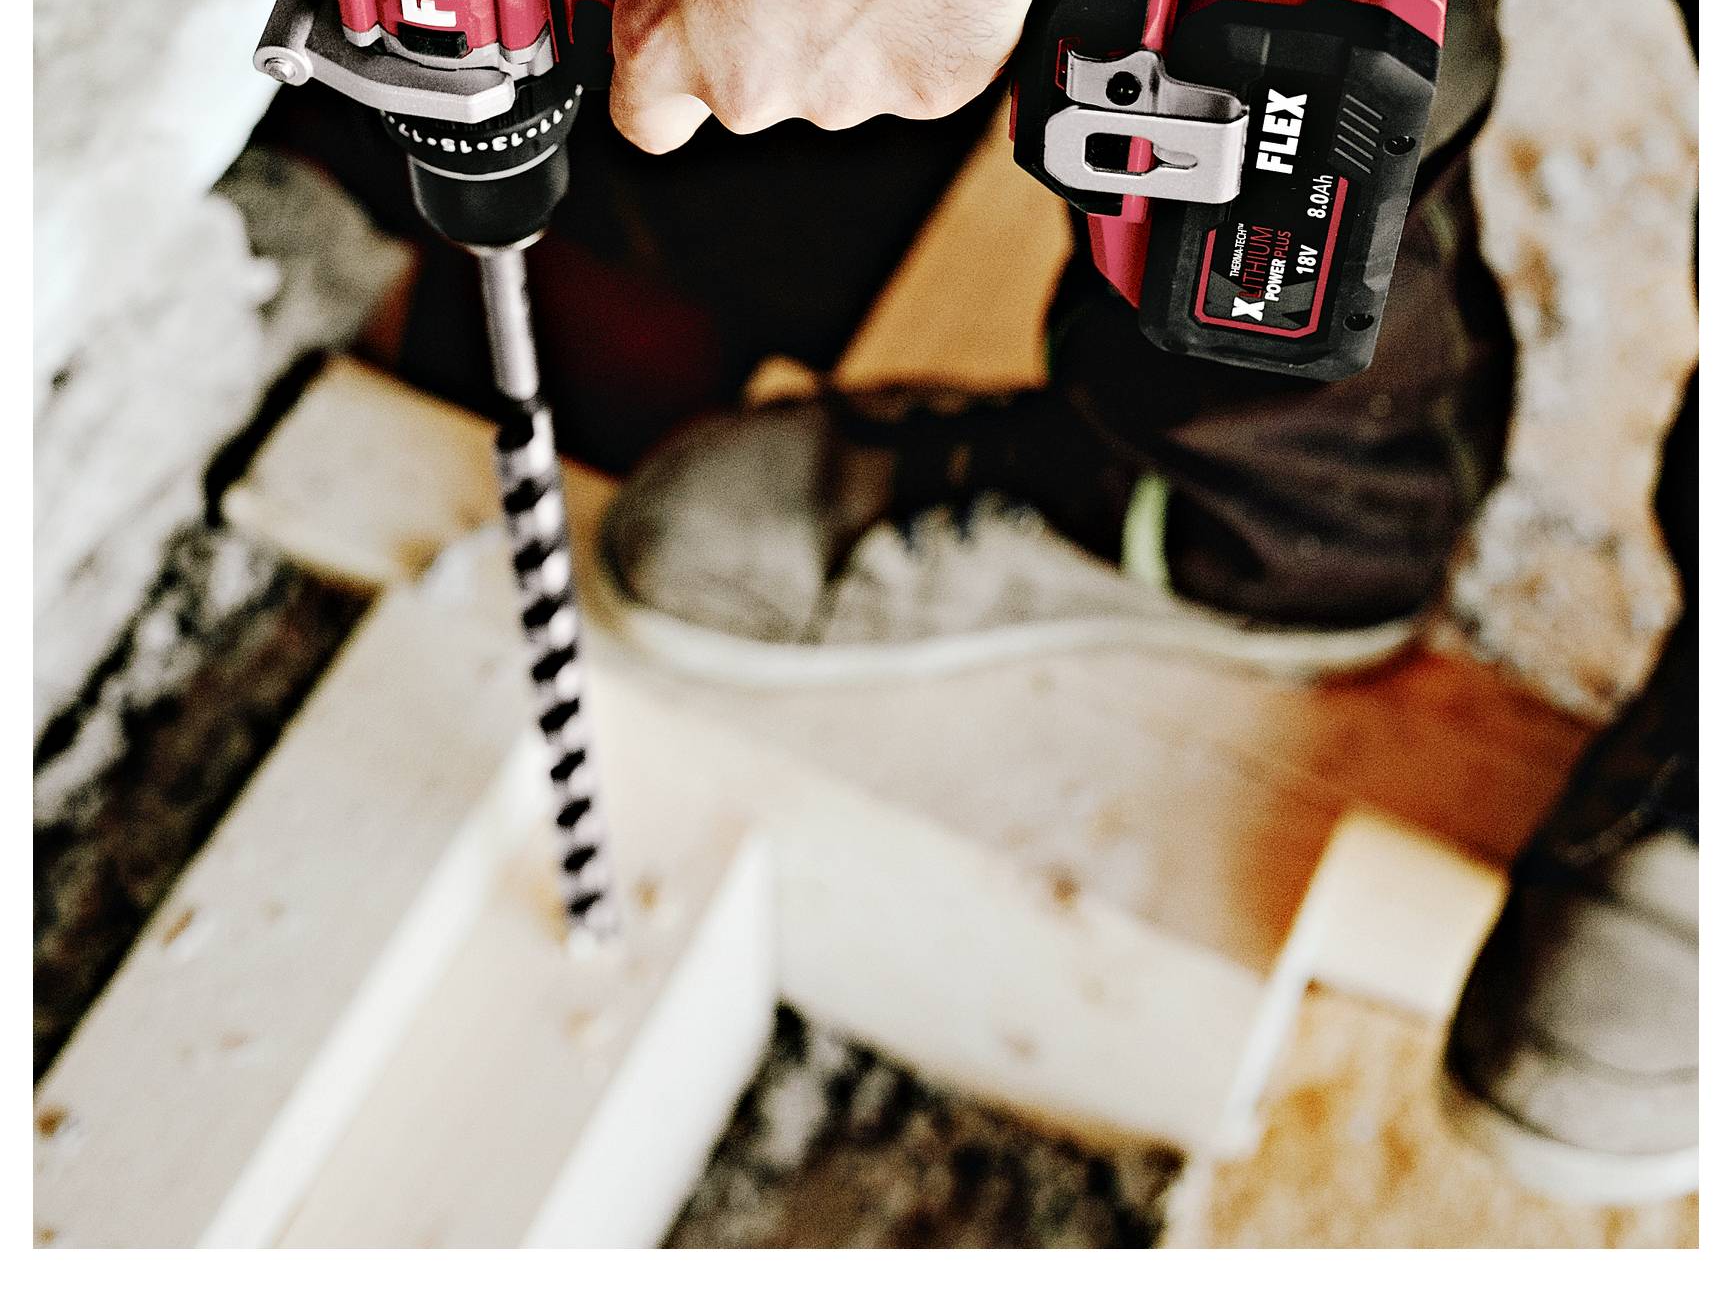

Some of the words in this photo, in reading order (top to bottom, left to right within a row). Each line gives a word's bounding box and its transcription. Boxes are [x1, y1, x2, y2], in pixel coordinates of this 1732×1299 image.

[1255, 88, 1308, 175] FLEX
[1273, 230, 1292, 258] PLUS
[1295, 243, 1319, 275] 18V
[1307, 174, 1334, 219] 8.0Ah
[1238, 225, 1274, 299] LITHIUM
[1264, 258, 1287, 302] POWER
